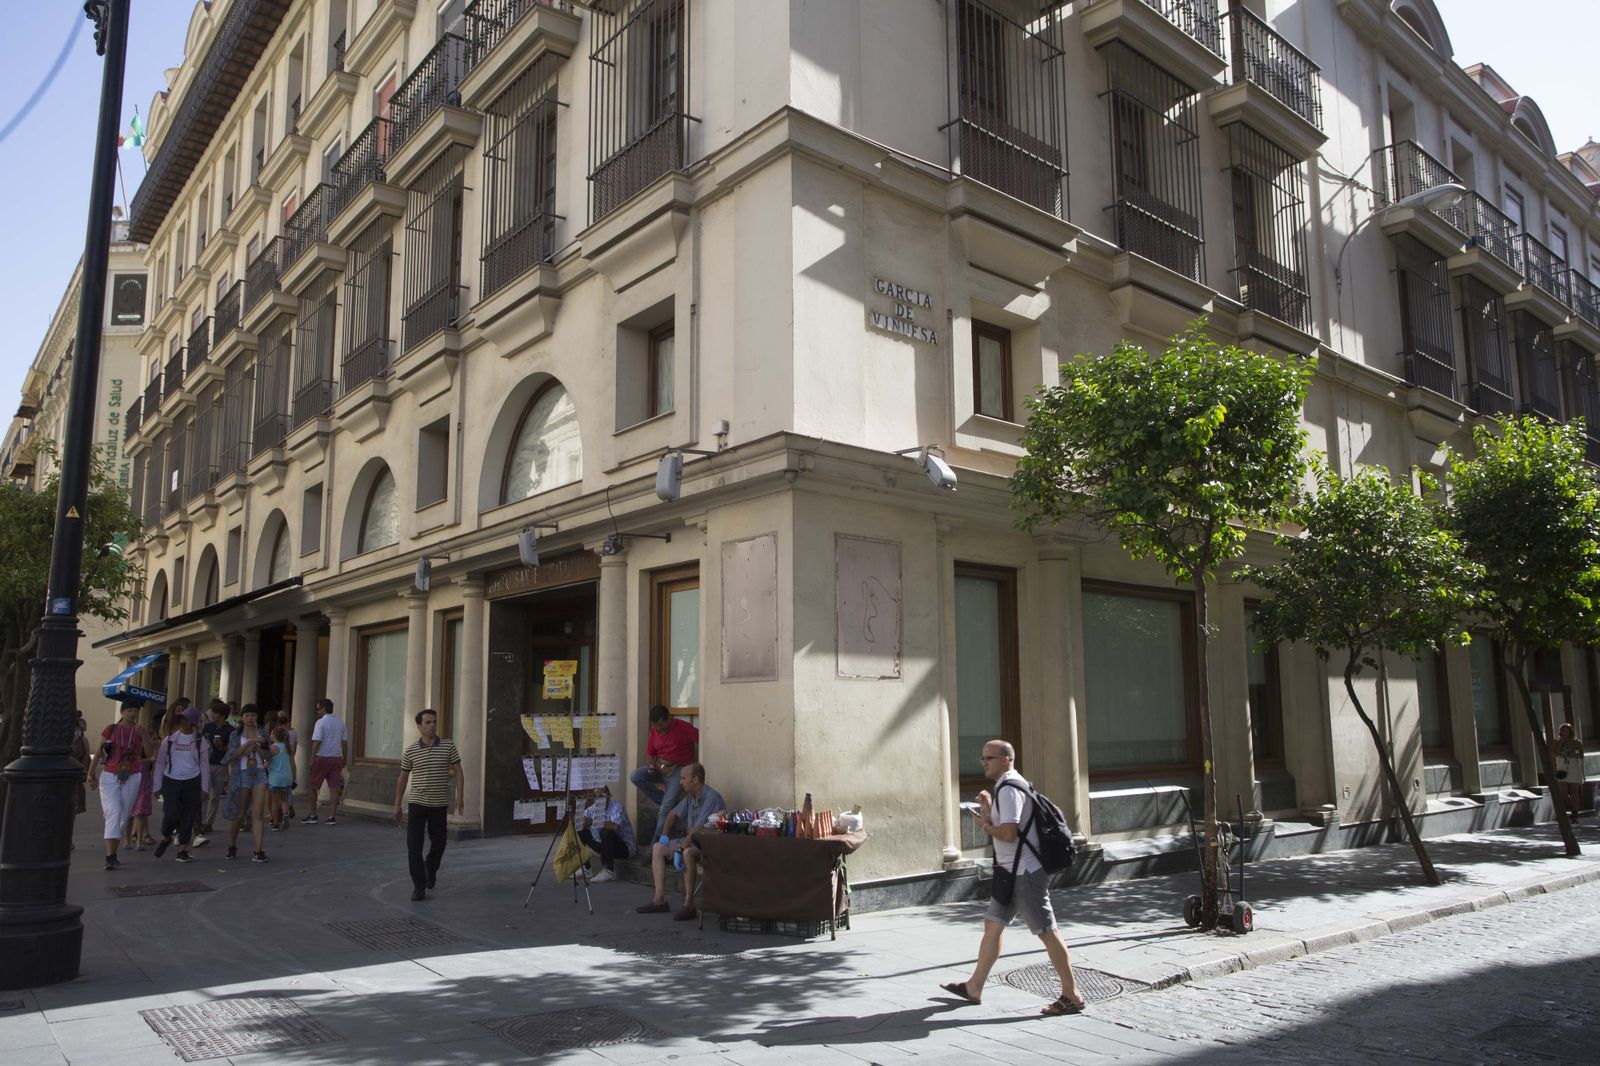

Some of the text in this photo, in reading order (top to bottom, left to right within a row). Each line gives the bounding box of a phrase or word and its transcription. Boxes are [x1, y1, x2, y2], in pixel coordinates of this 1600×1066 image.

[896, 303, 914, 320] DE
[872, 312, 937, 344] VINUESA
[108, 379, 122, 407] Salud
[107, 411, 119, 425] de
[103, 429, 118, 473] Andaluz
[130, 687, 166, 702] CHANGE
